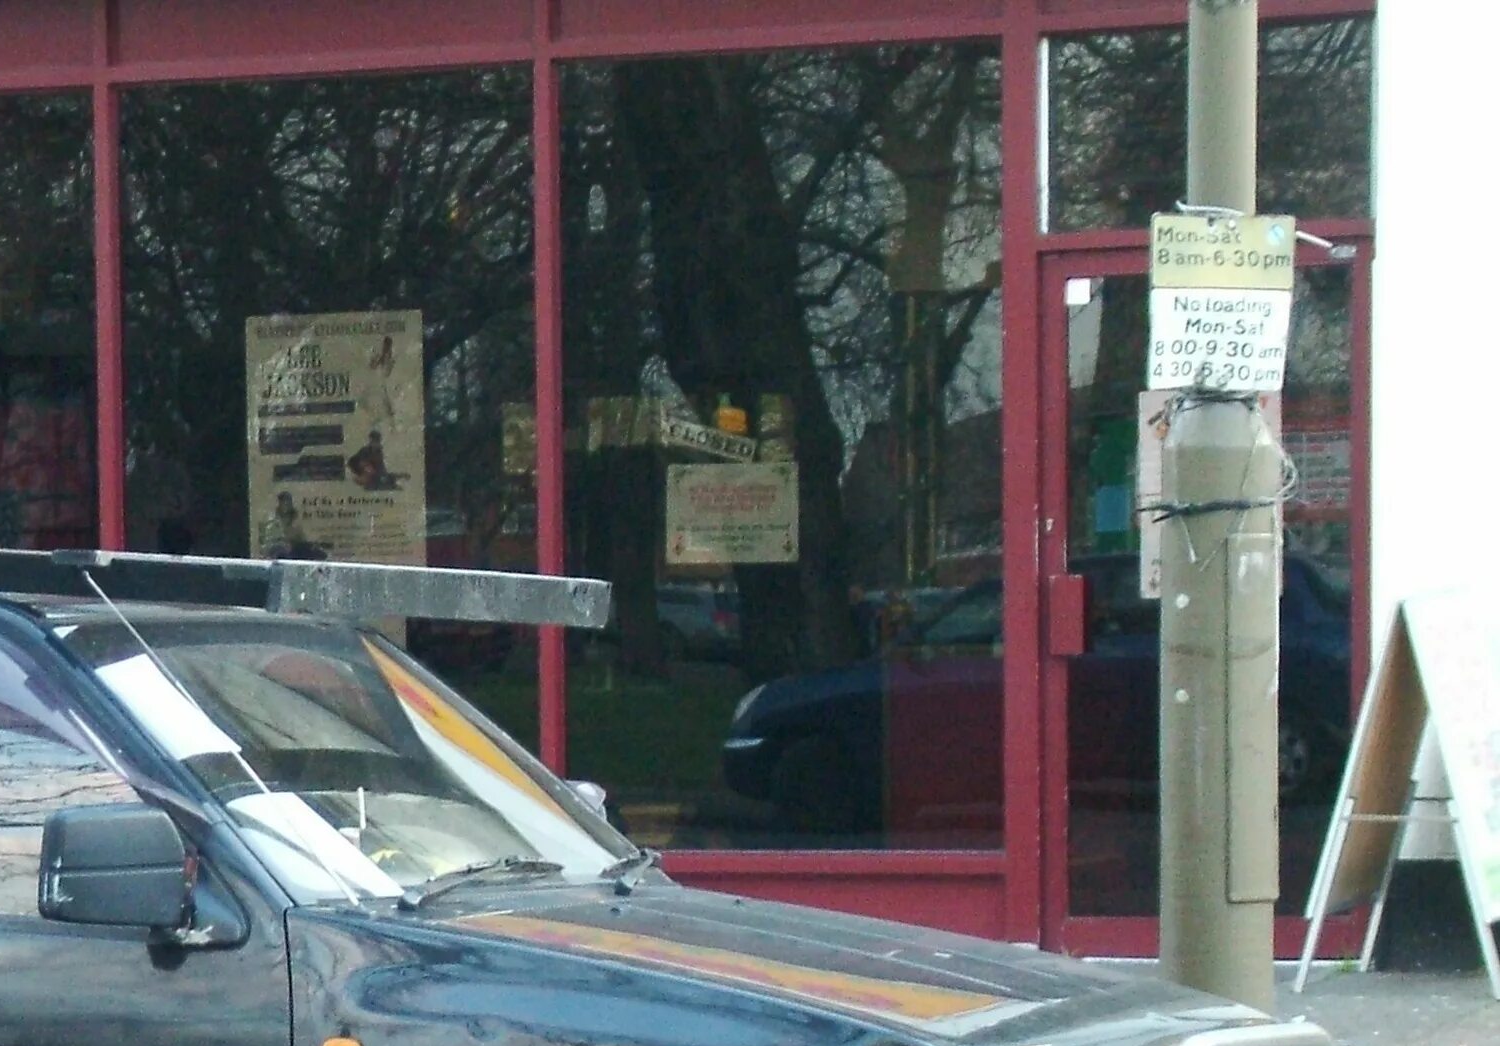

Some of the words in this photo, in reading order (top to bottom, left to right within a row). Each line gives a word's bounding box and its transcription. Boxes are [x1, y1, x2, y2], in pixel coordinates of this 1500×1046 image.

[1157, 226, 1242, 245] Mon-Sat
[1173, 296, 1201, 312] No
[1206, 298, 1272, 317] loading
[1184, 318, 1265, 335] Mon-Sat
[669, 423, 753, 455] CLOSED
